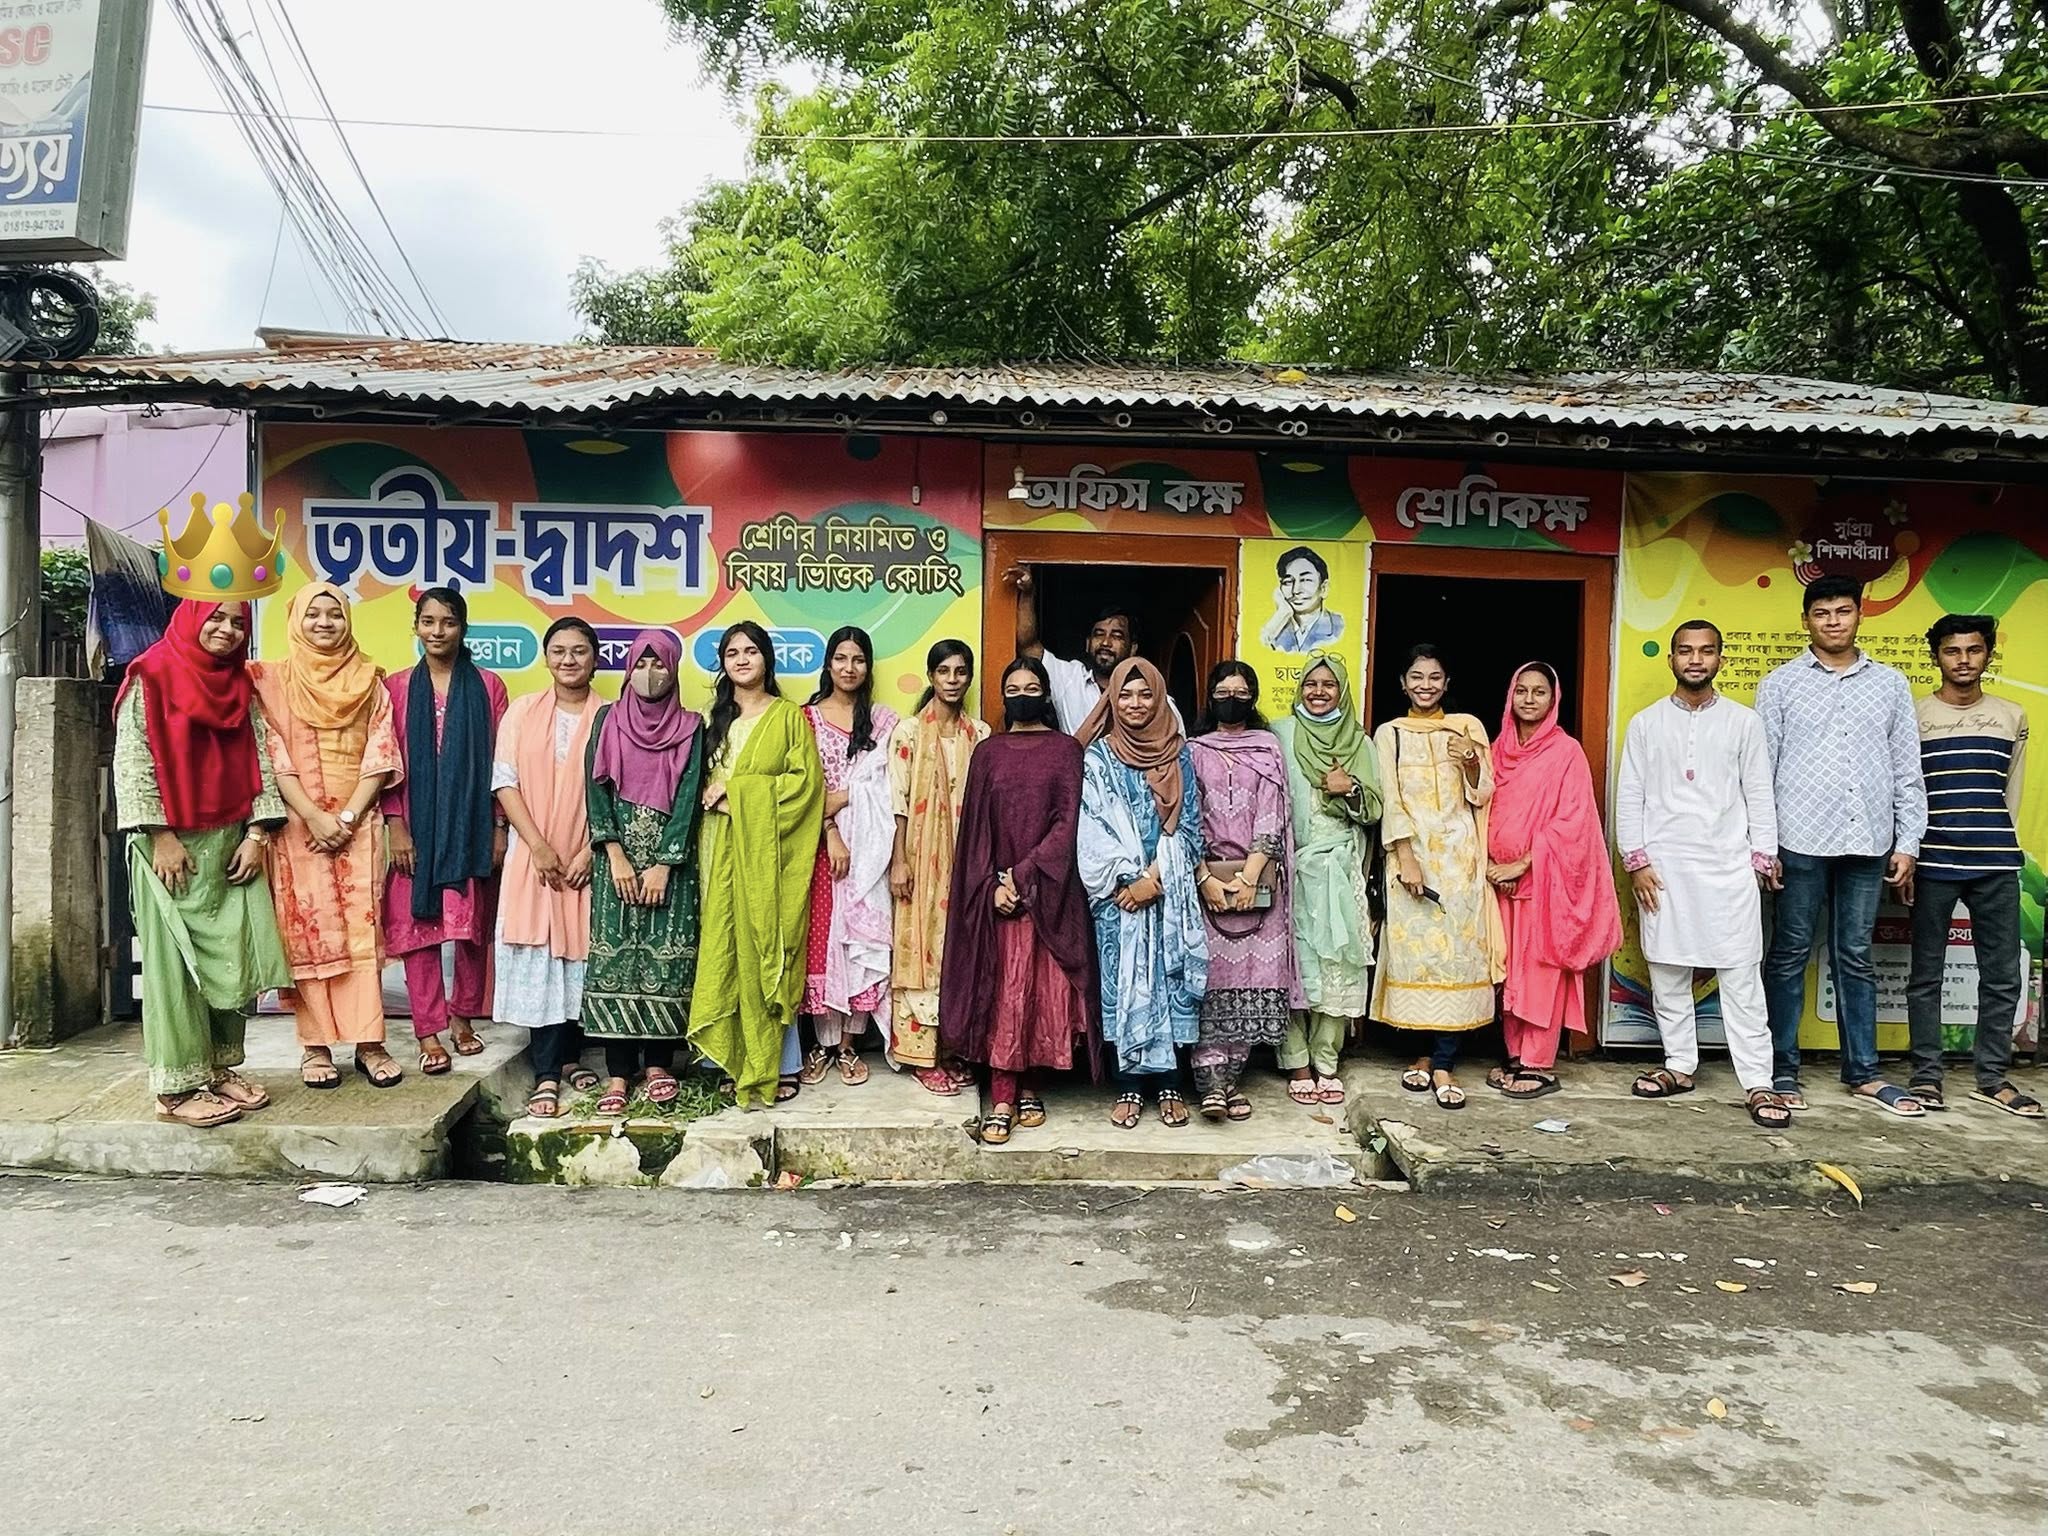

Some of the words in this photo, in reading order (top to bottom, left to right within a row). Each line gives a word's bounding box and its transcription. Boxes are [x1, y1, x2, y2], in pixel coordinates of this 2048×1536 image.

[1023, 463, 1151, 512] অফিস
[1163, 479, 1245, 514] কক্ষ
[1396, 473, 1591, 533] শ্রেণিকক্ষ
[742, 516, 817, 552] শ্রেণির
[825, 516, 917, 553] নিয়মিত
[926, 528, 948, 552] ও
[726, 552, 787, 589] বিষয়
[796, 553, 875, 590] ভিত্তিক
[885, 555, 963, 594] কোচিং
[463, 635, 523, 665] জ্ঞান
[1906, 675, 1933, 684] nce
